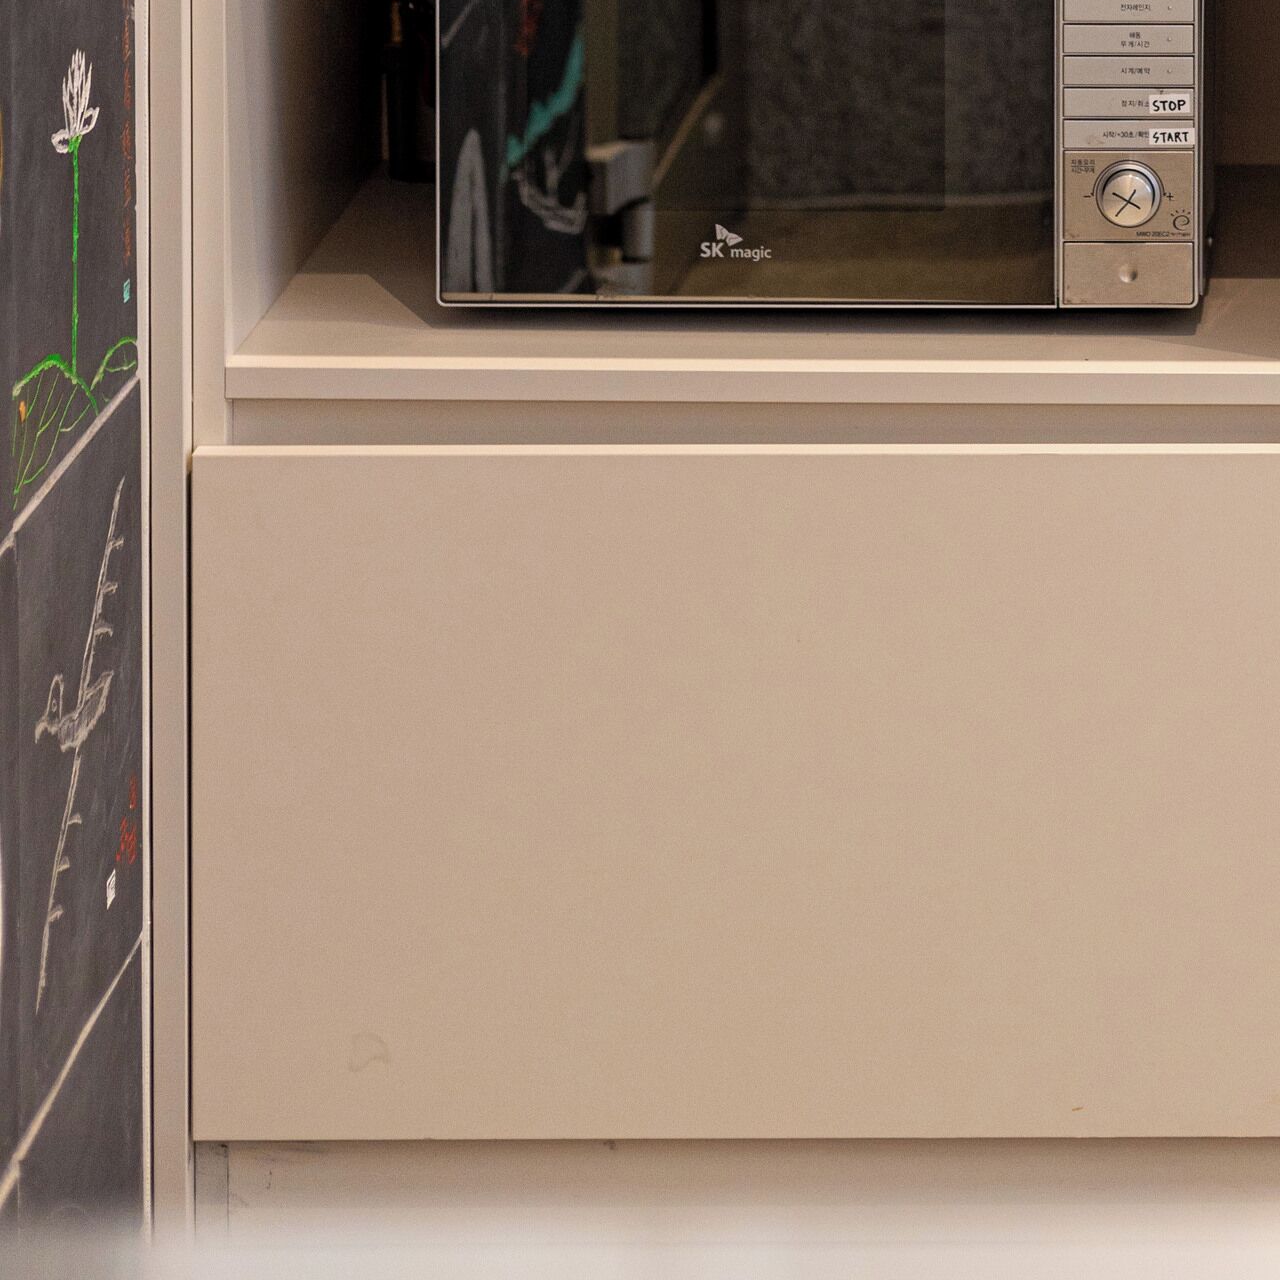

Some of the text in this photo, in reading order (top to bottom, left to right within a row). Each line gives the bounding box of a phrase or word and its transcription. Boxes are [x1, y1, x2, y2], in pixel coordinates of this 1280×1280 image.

[1120, 4, 1151, 12] 전자레인지
[1152, 100, 1186, 112] STOP
[1152, 132, 1189, 143] START
[700, 242, 772, 262] SK magic
